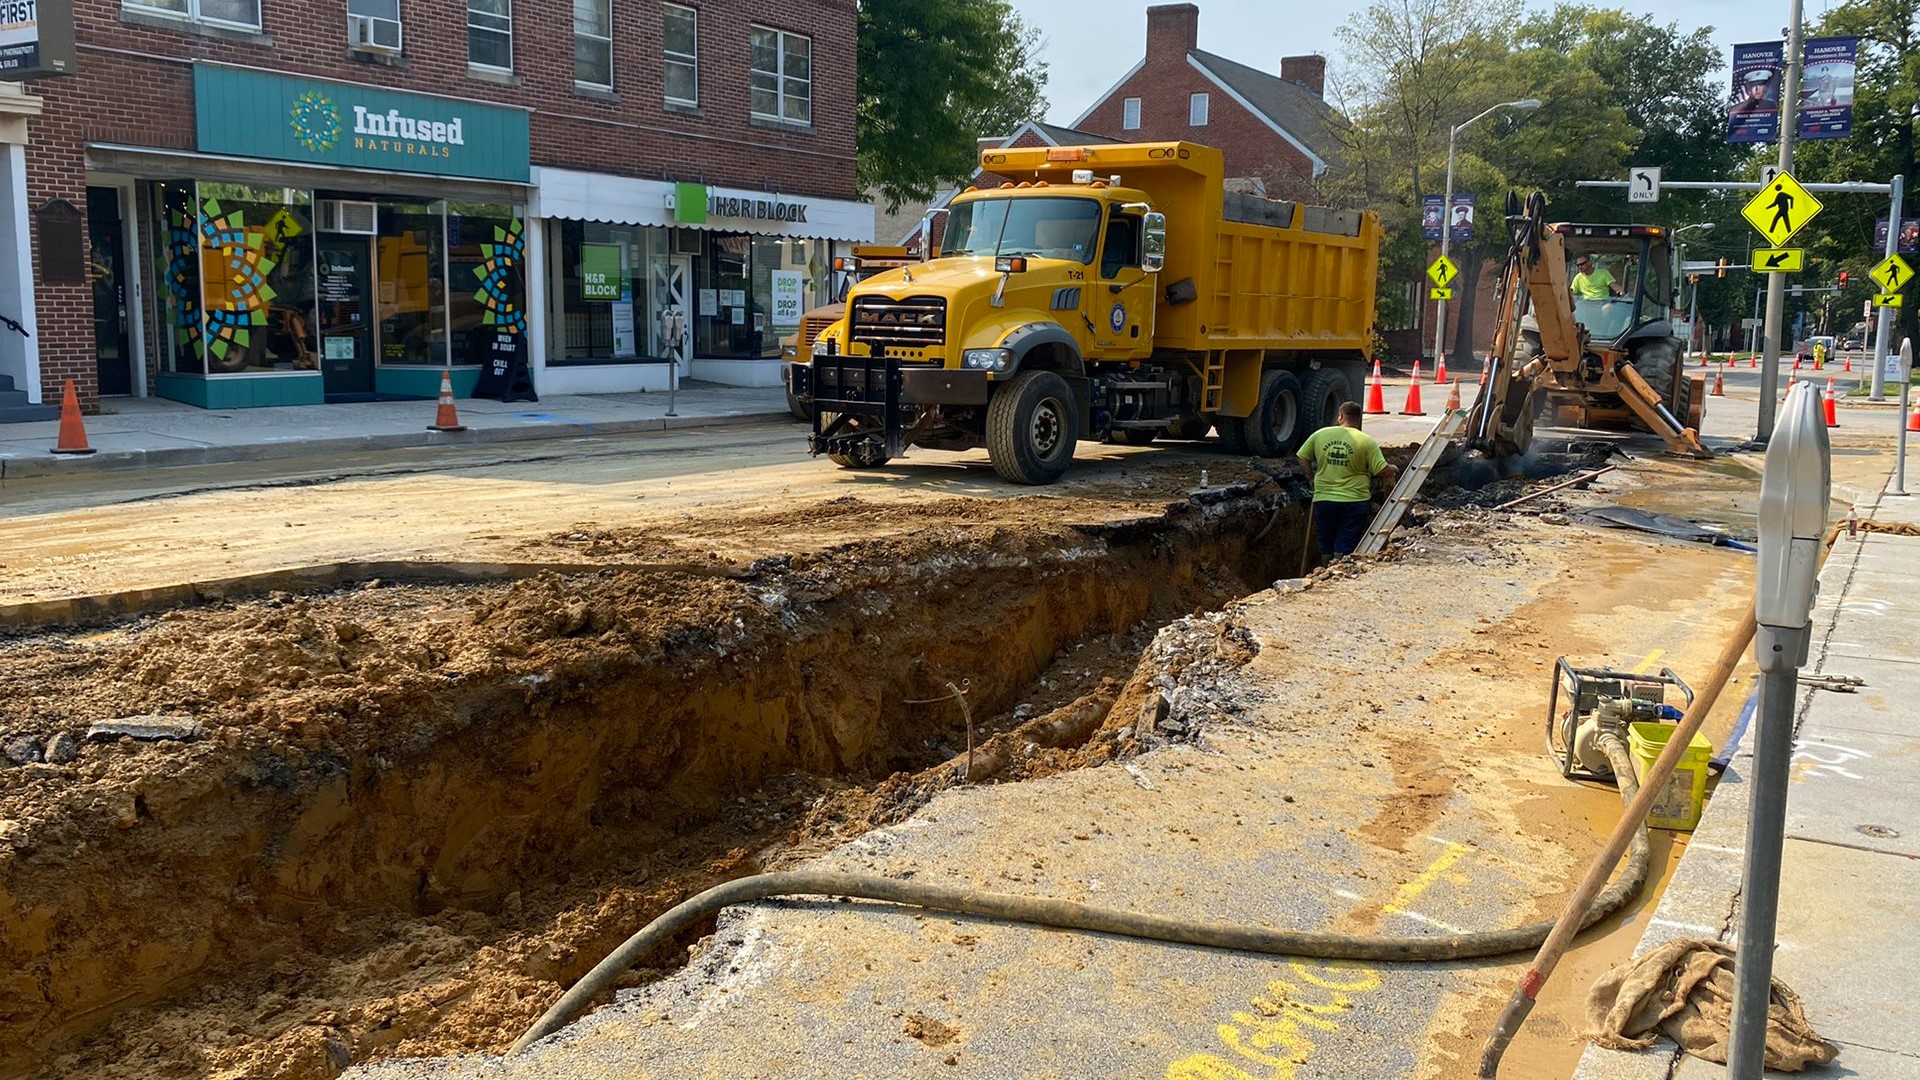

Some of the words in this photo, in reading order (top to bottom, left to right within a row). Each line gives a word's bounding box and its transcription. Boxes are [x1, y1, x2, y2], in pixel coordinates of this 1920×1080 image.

[0, 0, 34, 24] FIRST
[353, 106, 464, 145] Infused
[354, 138, 450, 158] NATURALS
[1633, 191, 1654, 199] ONLY
[715, 196, 752, 218] H&R
[756, 200, 808, 223] BLOCK
[584, 273, 606, 284] H&R
[1068, 271, 1084, 279] T-21
[777, 278, 797, 287] DROP
[585, 285, 617, 296] BLOCK
[777, 300, 797, 309] DROP
[861, 312, 936, 325] MACK
[497, 335, 512, 343] WHEN
[492, 342, 500, 350] IN
[500, 343, 516, 352] DOUBT
[493, 359, 508, 368] CHILL
[494, 368, 504, 376] OUT
